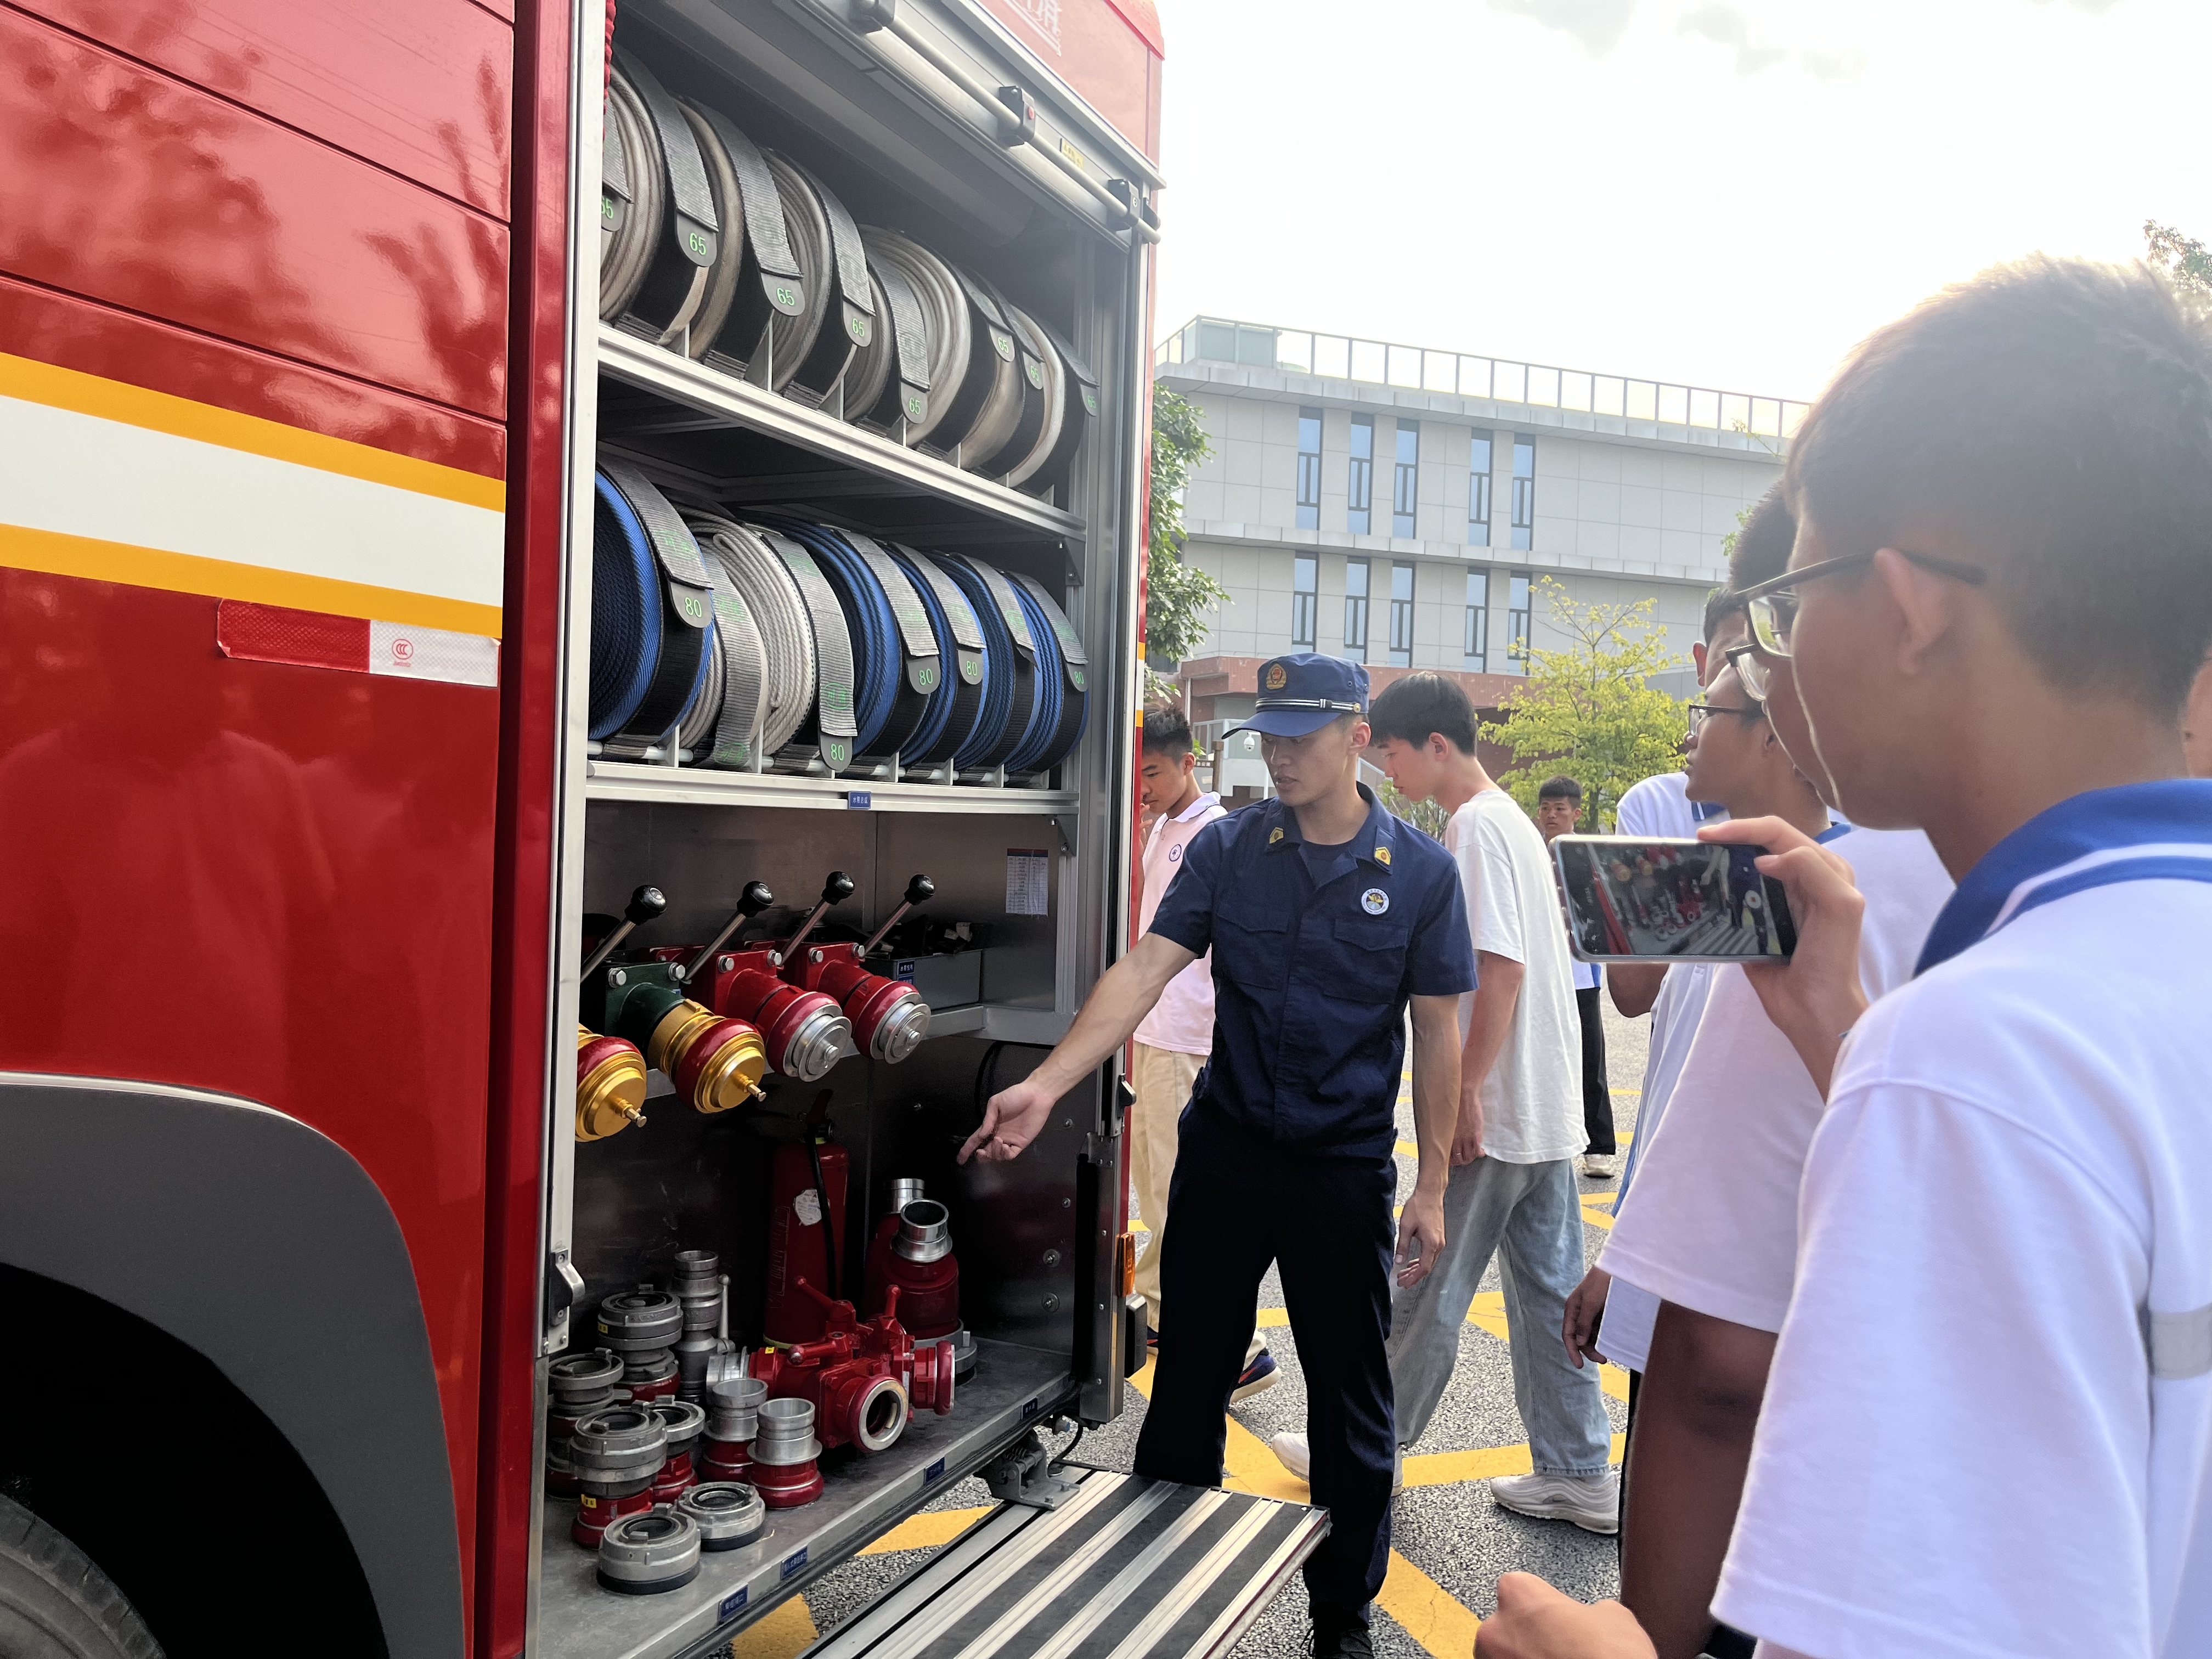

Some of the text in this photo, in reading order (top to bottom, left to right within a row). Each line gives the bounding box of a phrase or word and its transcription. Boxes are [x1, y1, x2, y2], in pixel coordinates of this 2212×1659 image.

[690, 233, 707, 255] 65
[776, 287, 794, 306] 65
[852, 318, 865, 336] 65
[997, 337, 1008, 352] 65
[1030, 365, 1040, 381] 65
[909, 397, 921, 414] 65
[1088, 395, 1096, 409] 65
[685, 597, 702, 618] 80
[966, 660, 978, 676] 80
[919, 668, 933, 686] 80
[1074, 671, 1084, 685] 80
[831, 743, 844, 761] 80
